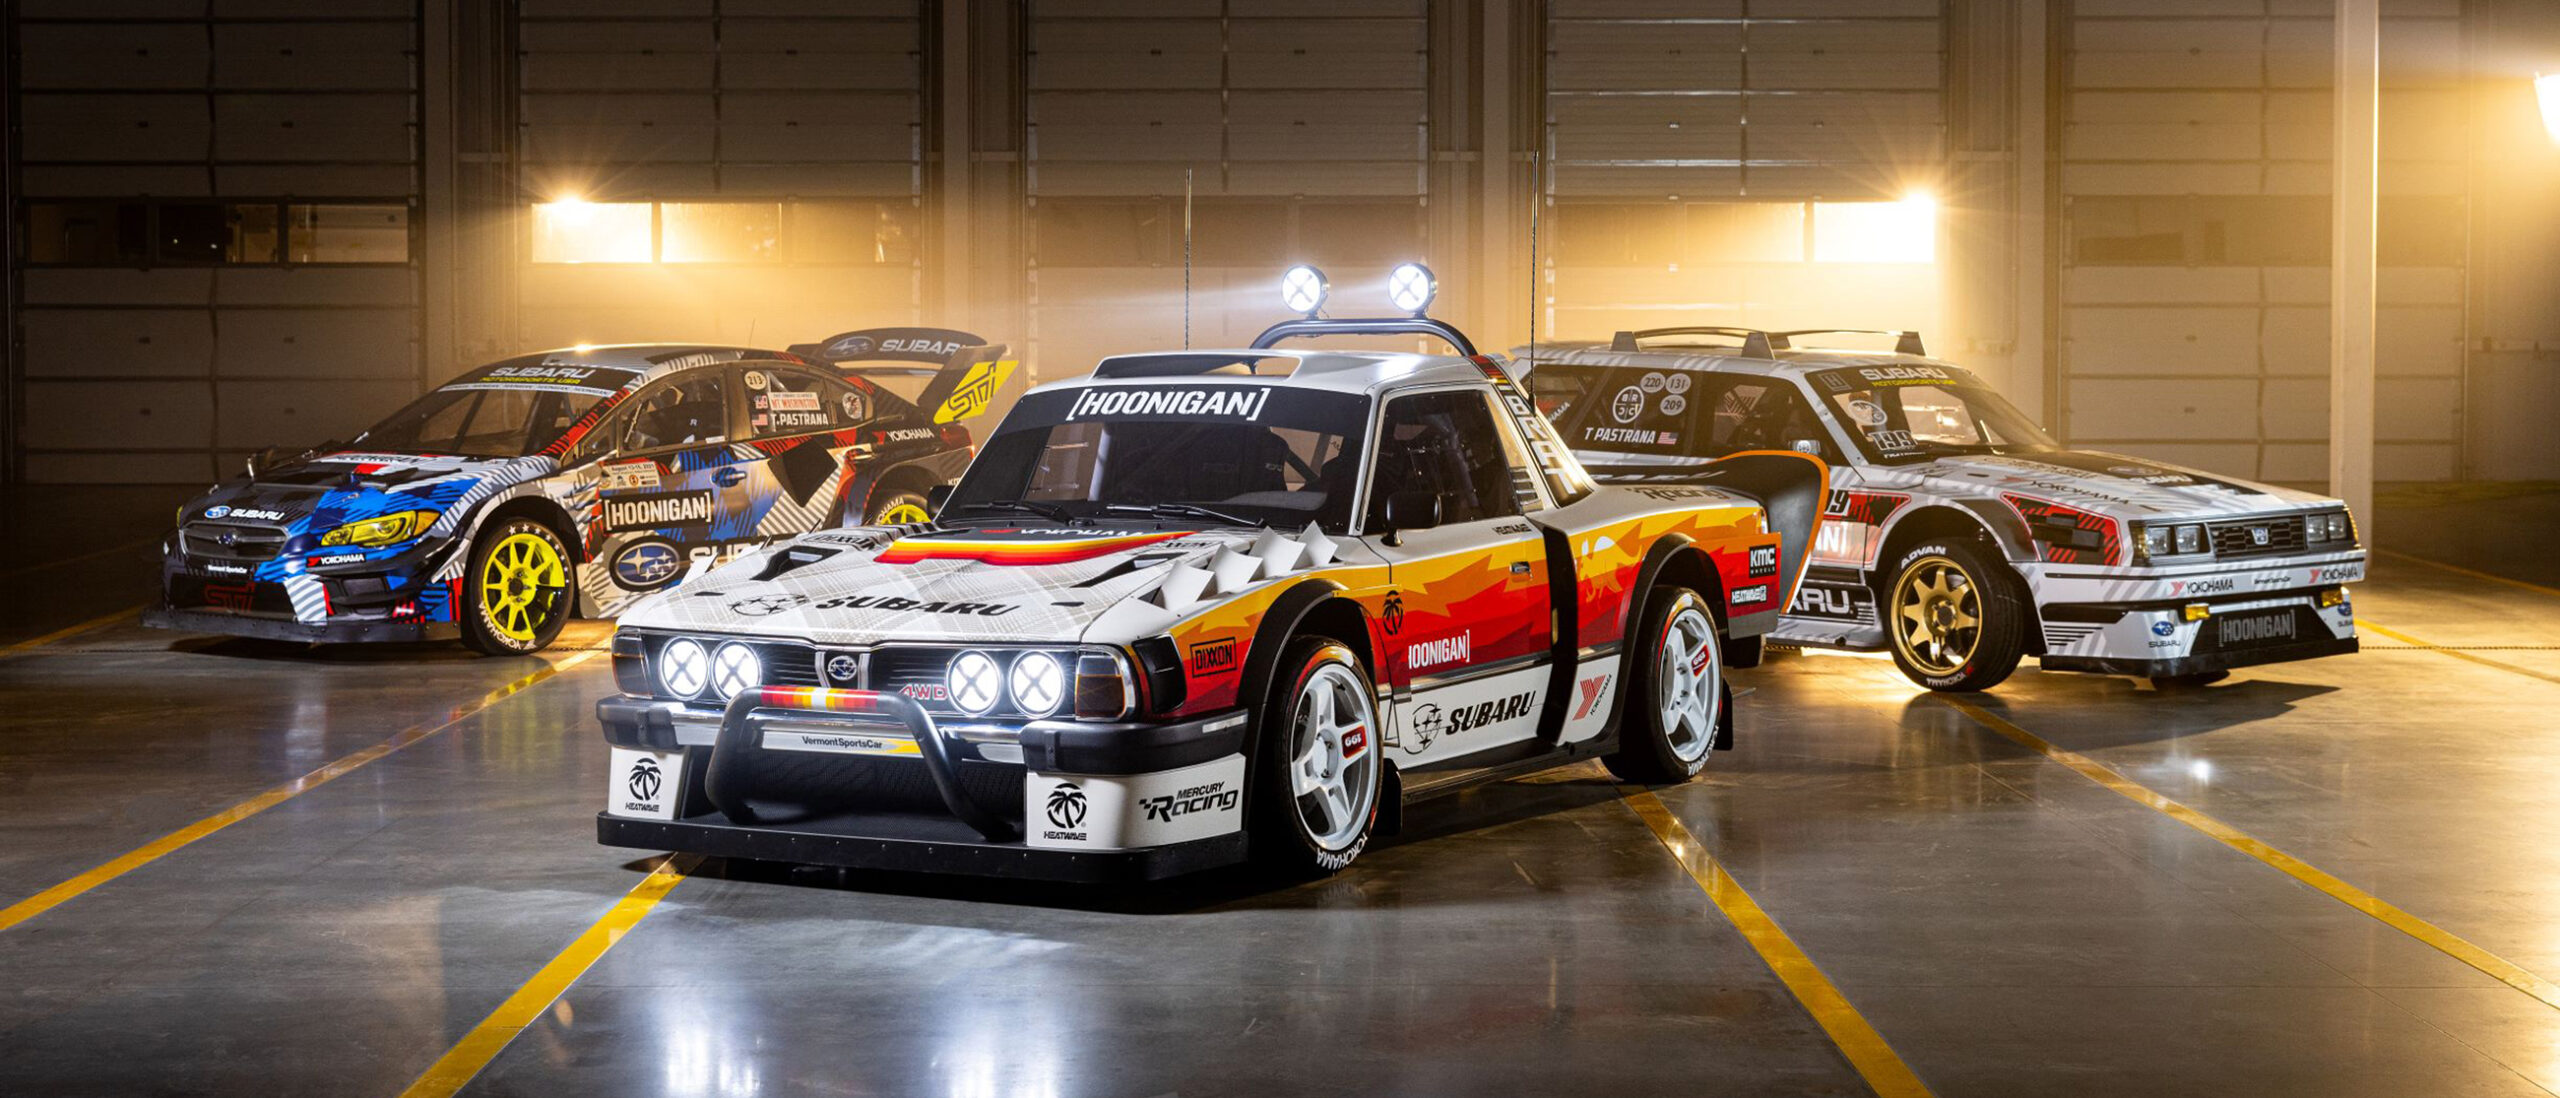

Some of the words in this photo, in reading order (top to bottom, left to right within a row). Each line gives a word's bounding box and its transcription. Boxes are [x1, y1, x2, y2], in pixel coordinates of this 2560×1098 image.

[489, 366, 597, 379] SUBARU
[1858, 367, 1949, 381] SUBARU
[1644, 377, 1661, 388] 220
[1670, 379, 1686, 389] 131
[1065, 387, 1272, 422] [HOONIGAN]
[1662, 400, 1682, 411] 209
[886, 427, 935, 443] YOKOHAMA
[1503, 395, 1578, 495] BRAT
[1584, 427, 1594, 441] T
[1594, 427, 1657, 445] PASTRANA
[2029, 480, 2130, 506] YOKOHAMA
[230, 508, 285, 521] SUBARU
[604, 491, 712, 531] [HOONIGAN]
[320, 553, 366, 565] YOKOHAMA
[1750, 547, 1776, 567] KMC
[1900, 545, 1947, 570] ADVAN
[2320, 566, 2358, 582] YOKOHAMA
[2186, 578, 2234, 594] YOKOHAMA
[815, 596, 1022, 617] SUBARU
[2218, 609, 2297, 648] [HOONIGAN]
[1194, 643, 1234, 670] DIXXON
[899, 683, 948, 700] 4WD
[1445, 690, 1537, 736] SUBARU
[1175, 780, 1226, 800] MERCURY
[1146, 789, 1240, 824] Racing
[1316, 831, 1369, 871] YOKOHAMA
